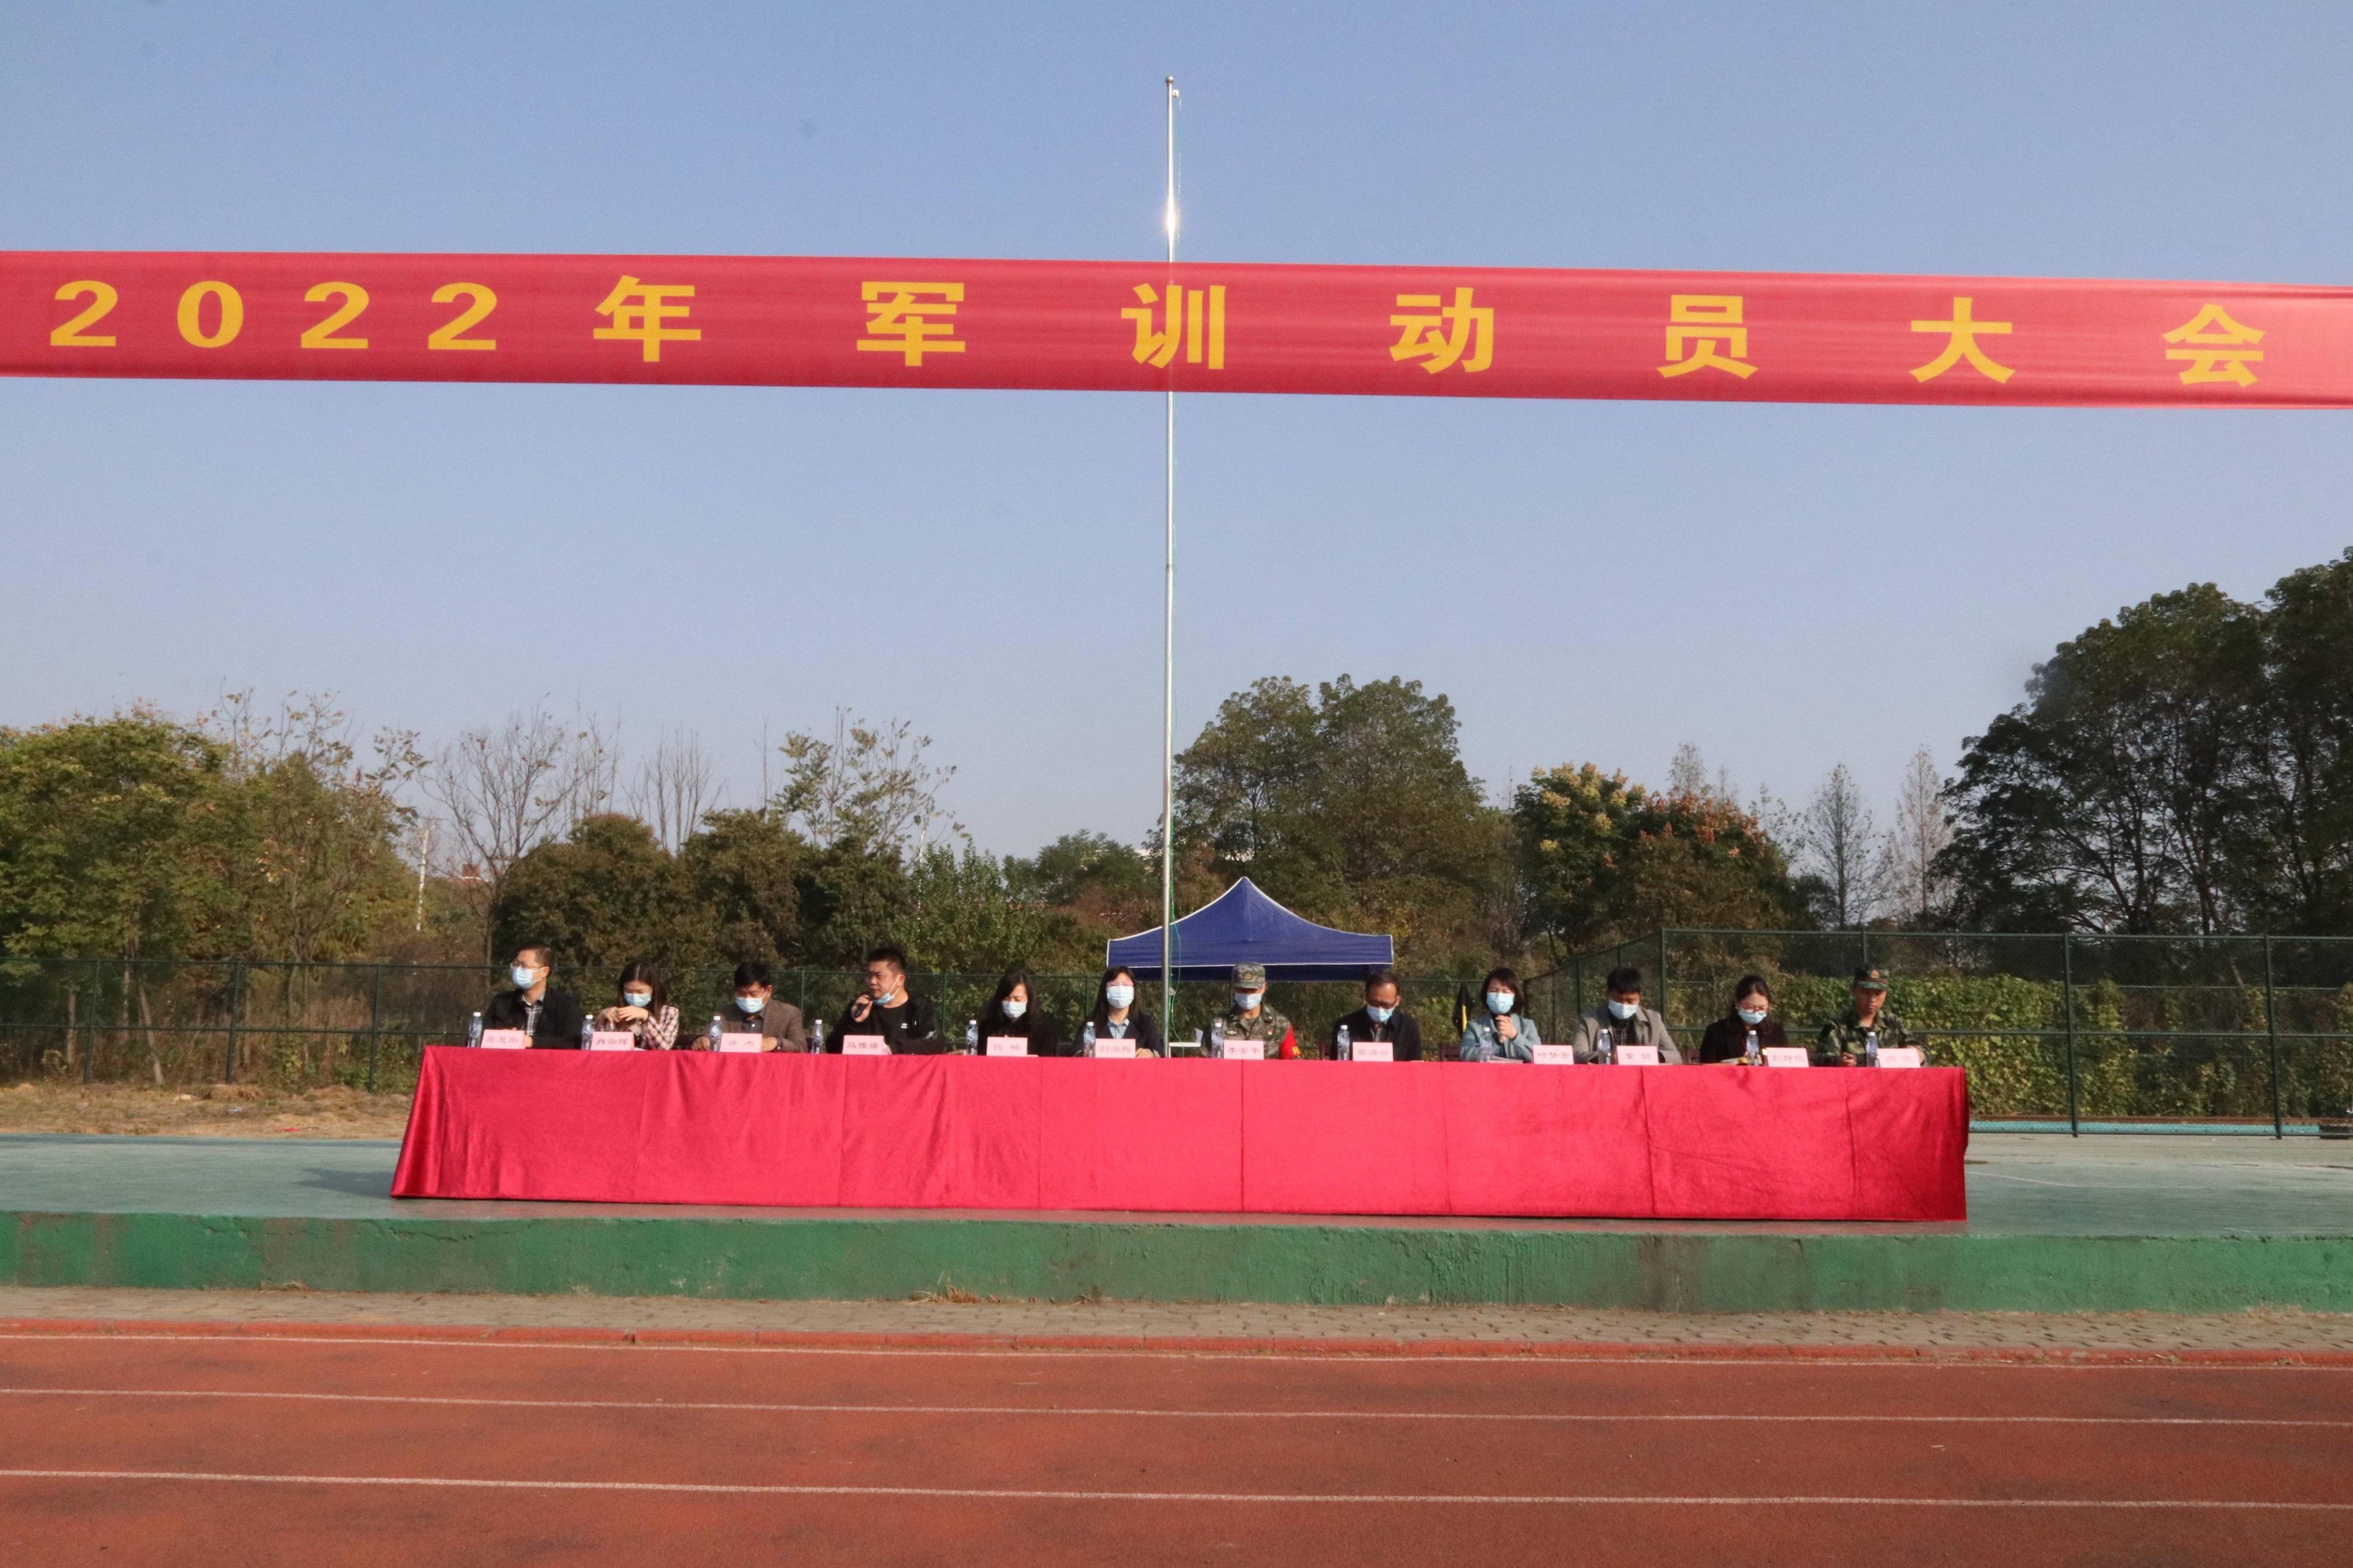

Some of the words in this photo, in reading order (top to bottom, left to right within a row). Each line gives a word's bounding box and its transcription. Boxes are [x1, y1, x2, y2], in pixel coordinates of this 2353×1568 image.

[50, 275, 2266, 387] 2022年军训动员大会
